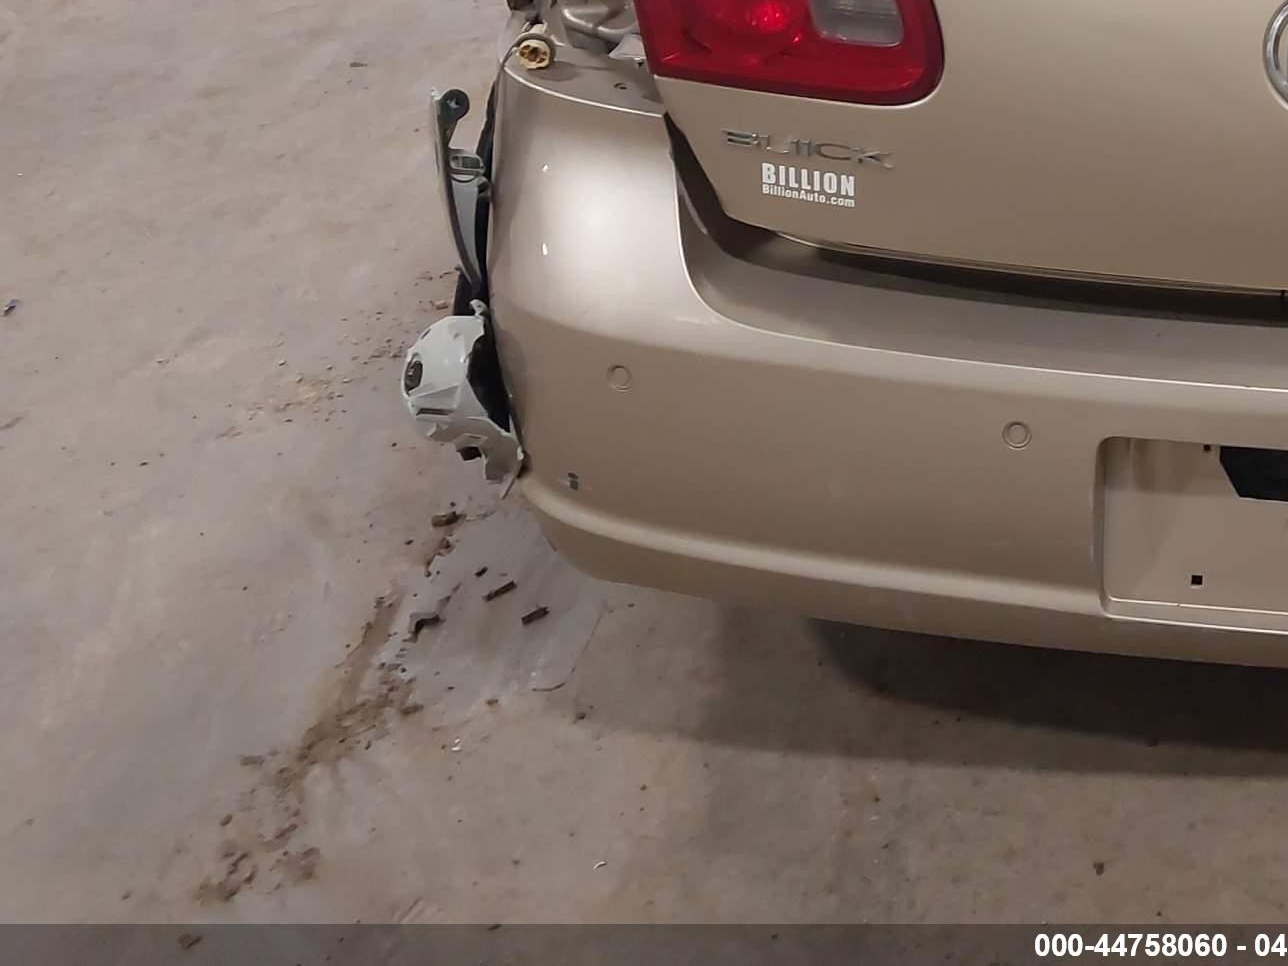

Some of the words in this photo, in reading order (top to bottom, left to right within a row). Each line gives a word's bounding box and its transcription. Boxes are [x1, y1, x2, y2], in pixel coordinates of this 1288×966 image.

[720, 128, 896, 170] BUICK
[761, 162, 856, 197] BILLION
[761, 183, 856, 208] BillionAuto.com
